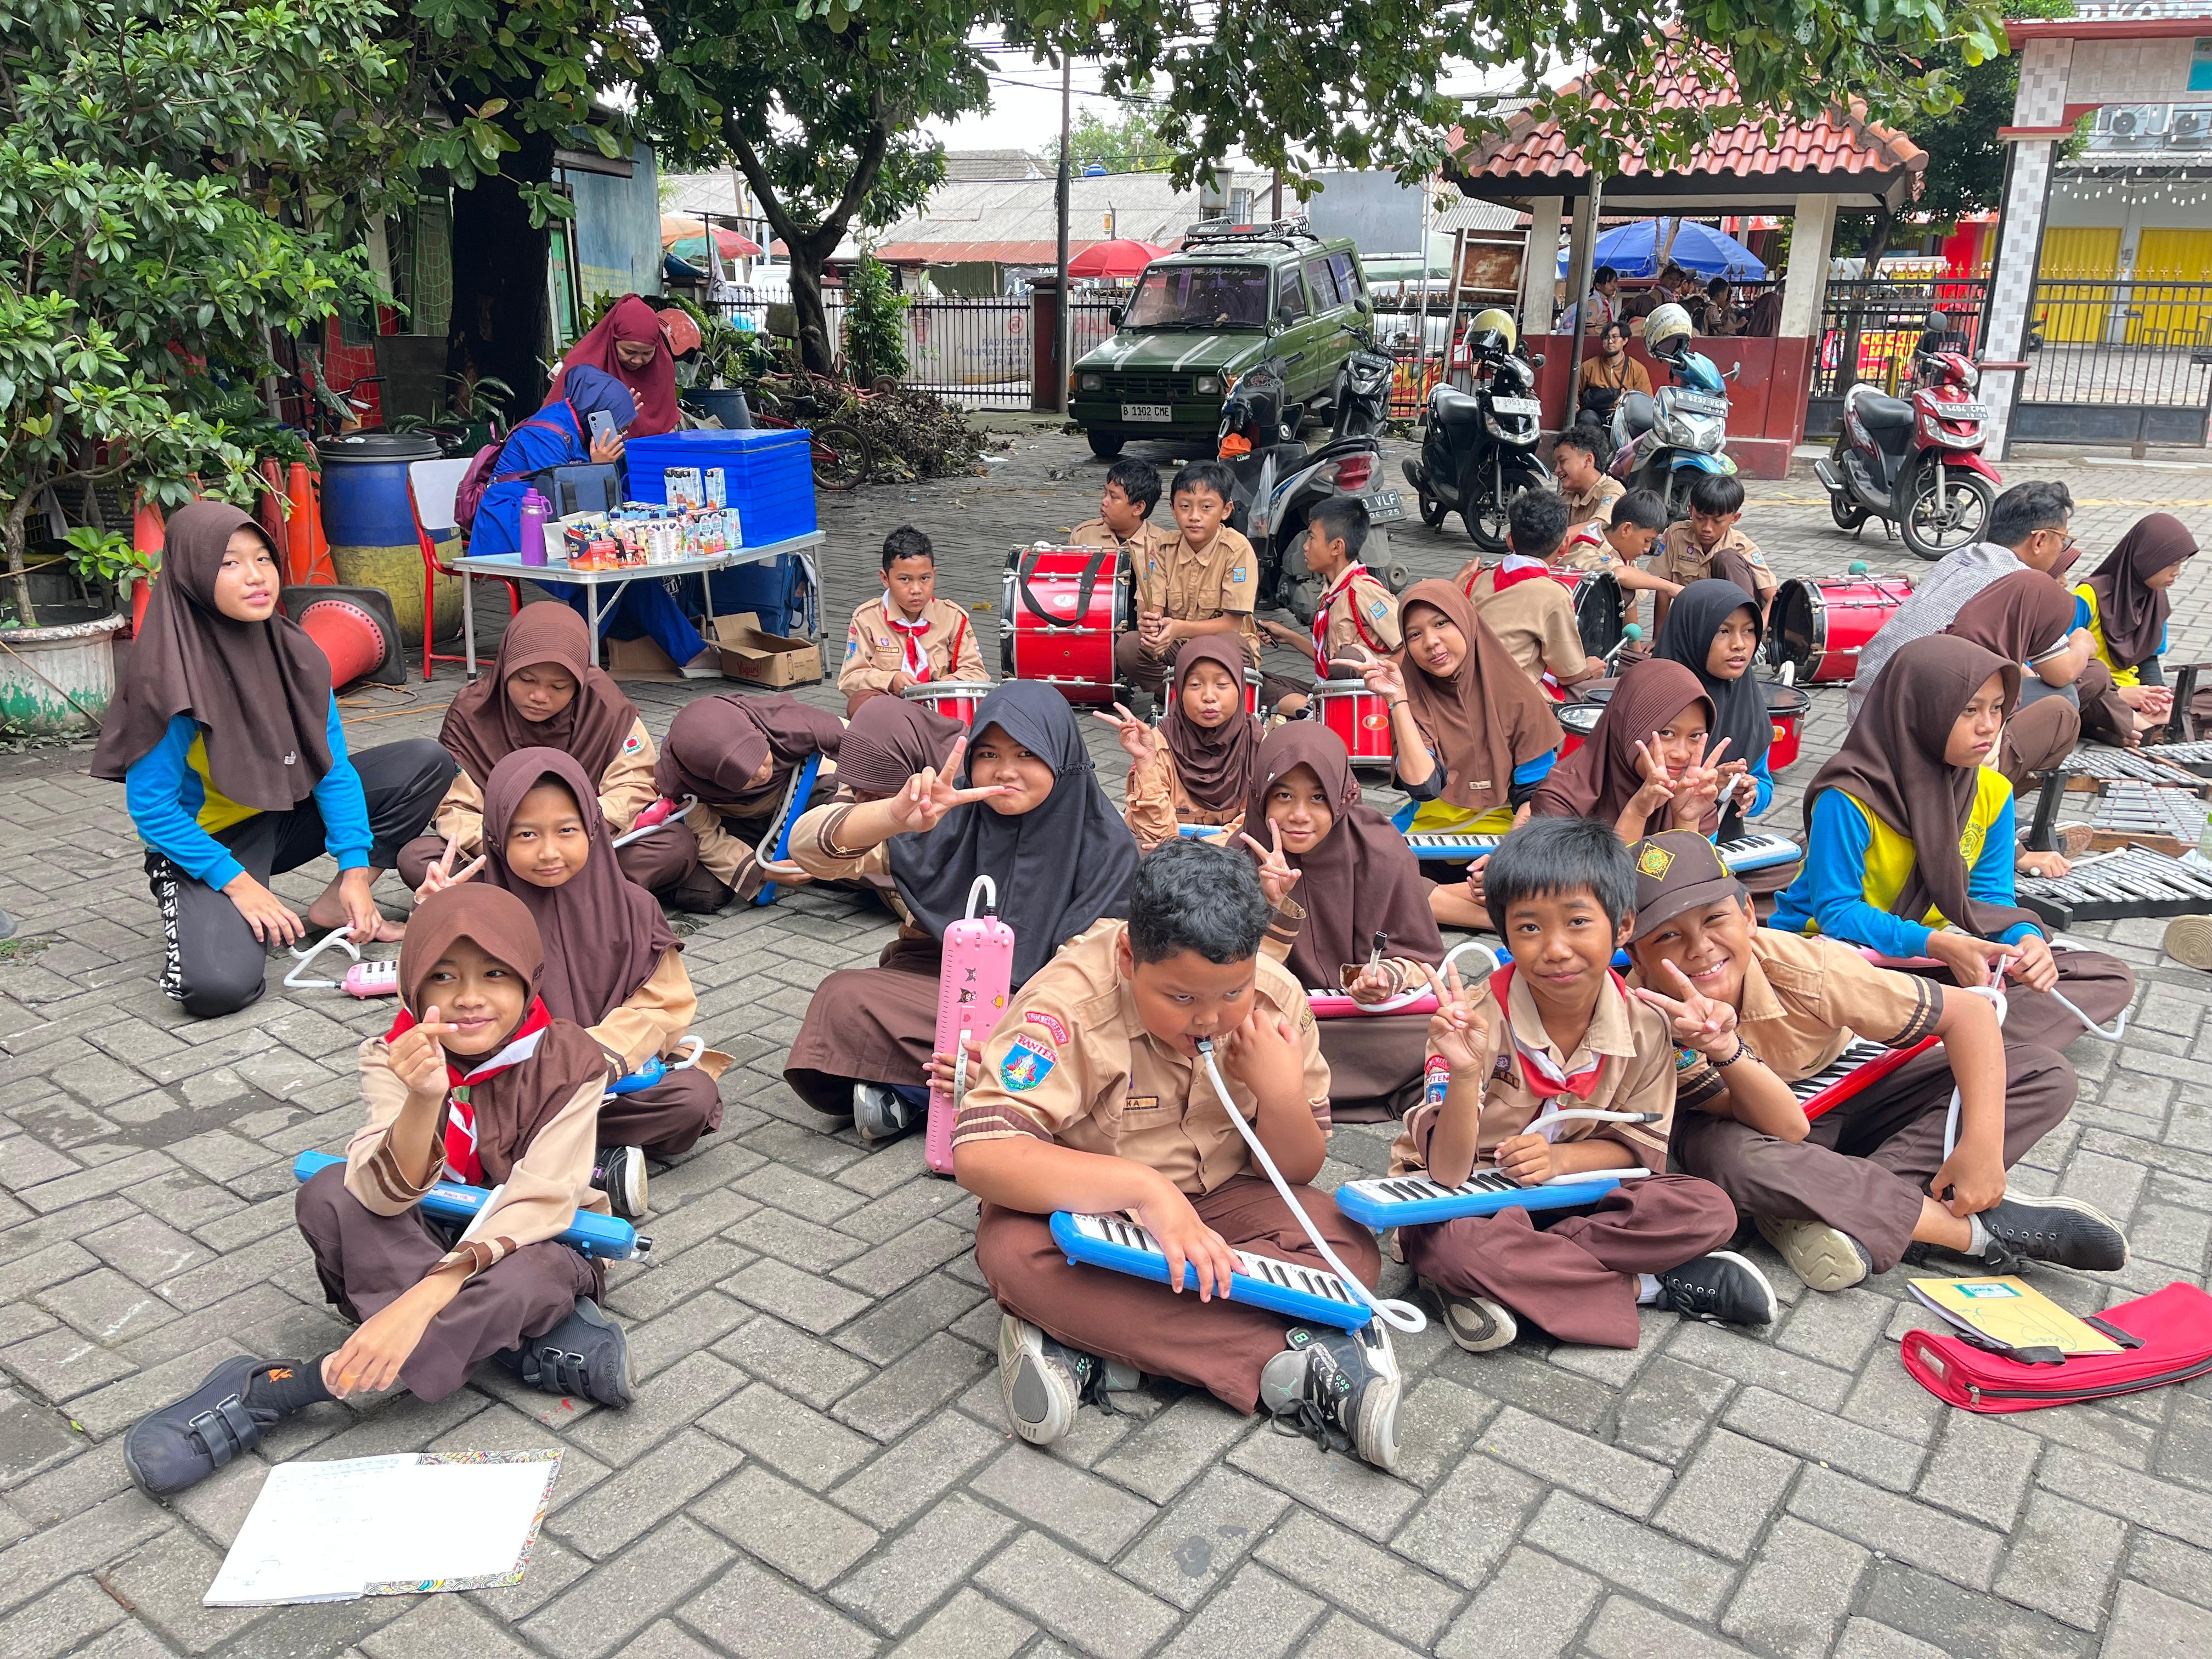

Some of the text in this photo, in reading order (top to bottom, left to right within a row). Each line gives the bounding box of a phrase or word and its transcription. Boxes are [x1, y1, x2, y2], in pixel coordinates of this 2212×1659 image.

[1123, 406, 1170, 416] B 1102 CME
[1374, 493, 1395, 506] VLF
[1018, 1034, 1057, 1063] BANTEN
